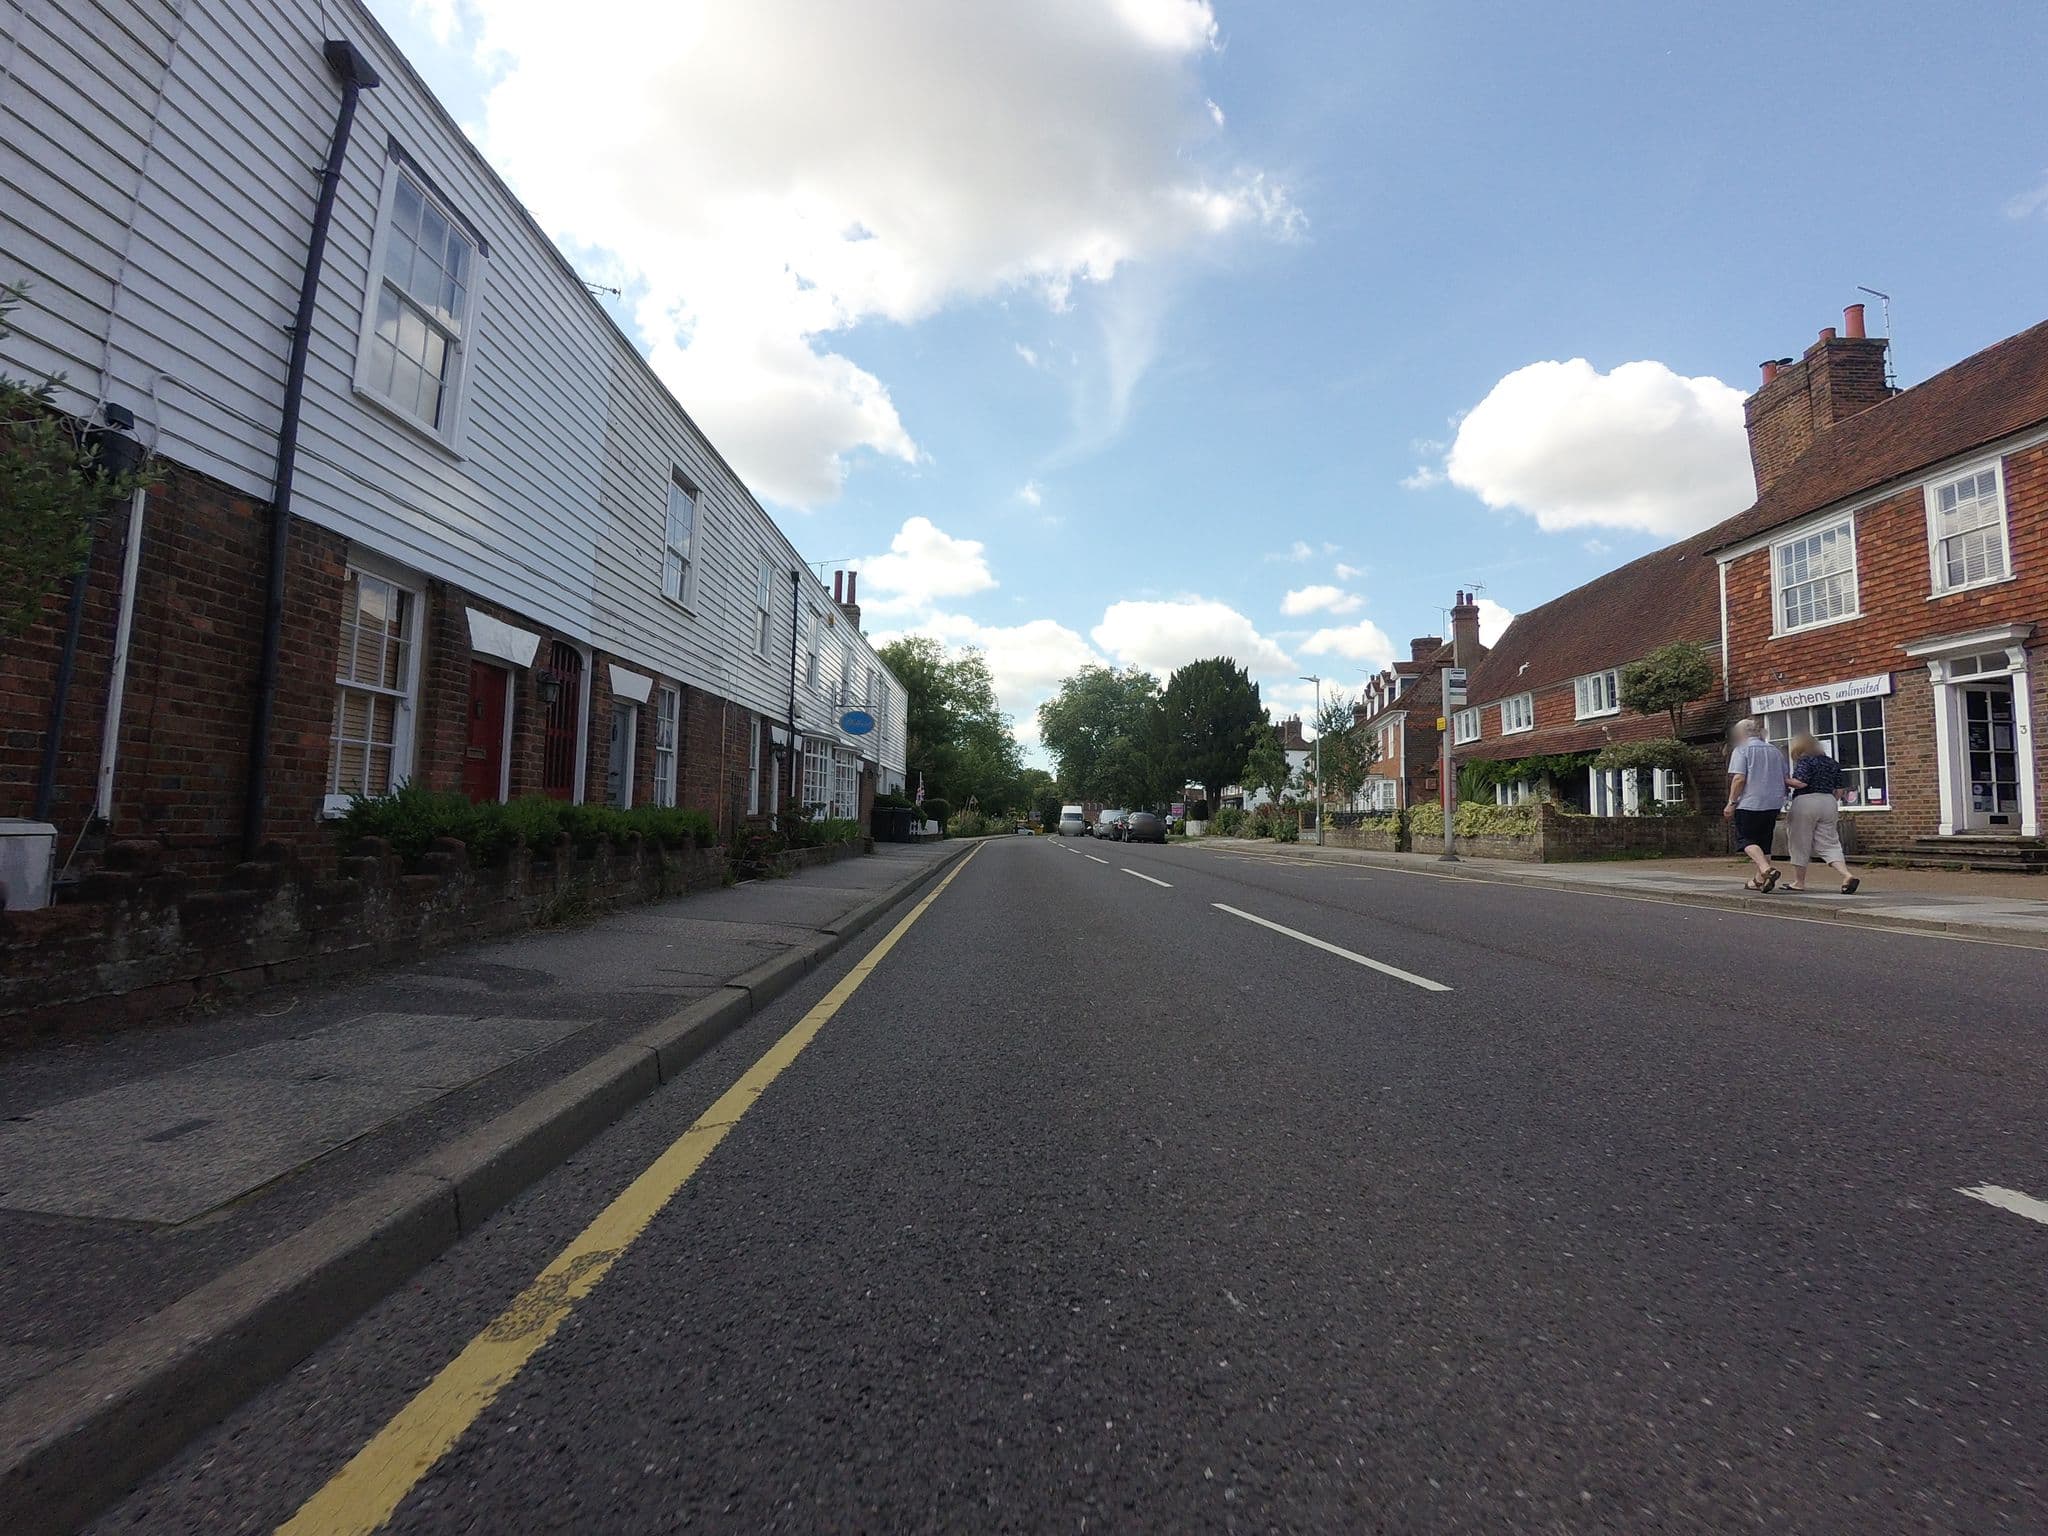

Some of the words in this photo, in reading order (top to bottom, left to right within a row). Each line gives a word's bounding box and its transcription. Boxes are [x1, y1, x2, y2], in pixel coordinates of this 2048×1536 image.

[1780, 691, 1831, 708] kitchens
[1835, 677, 1882, 700] unlimited
[2020, 724, 2028, 735] 3
